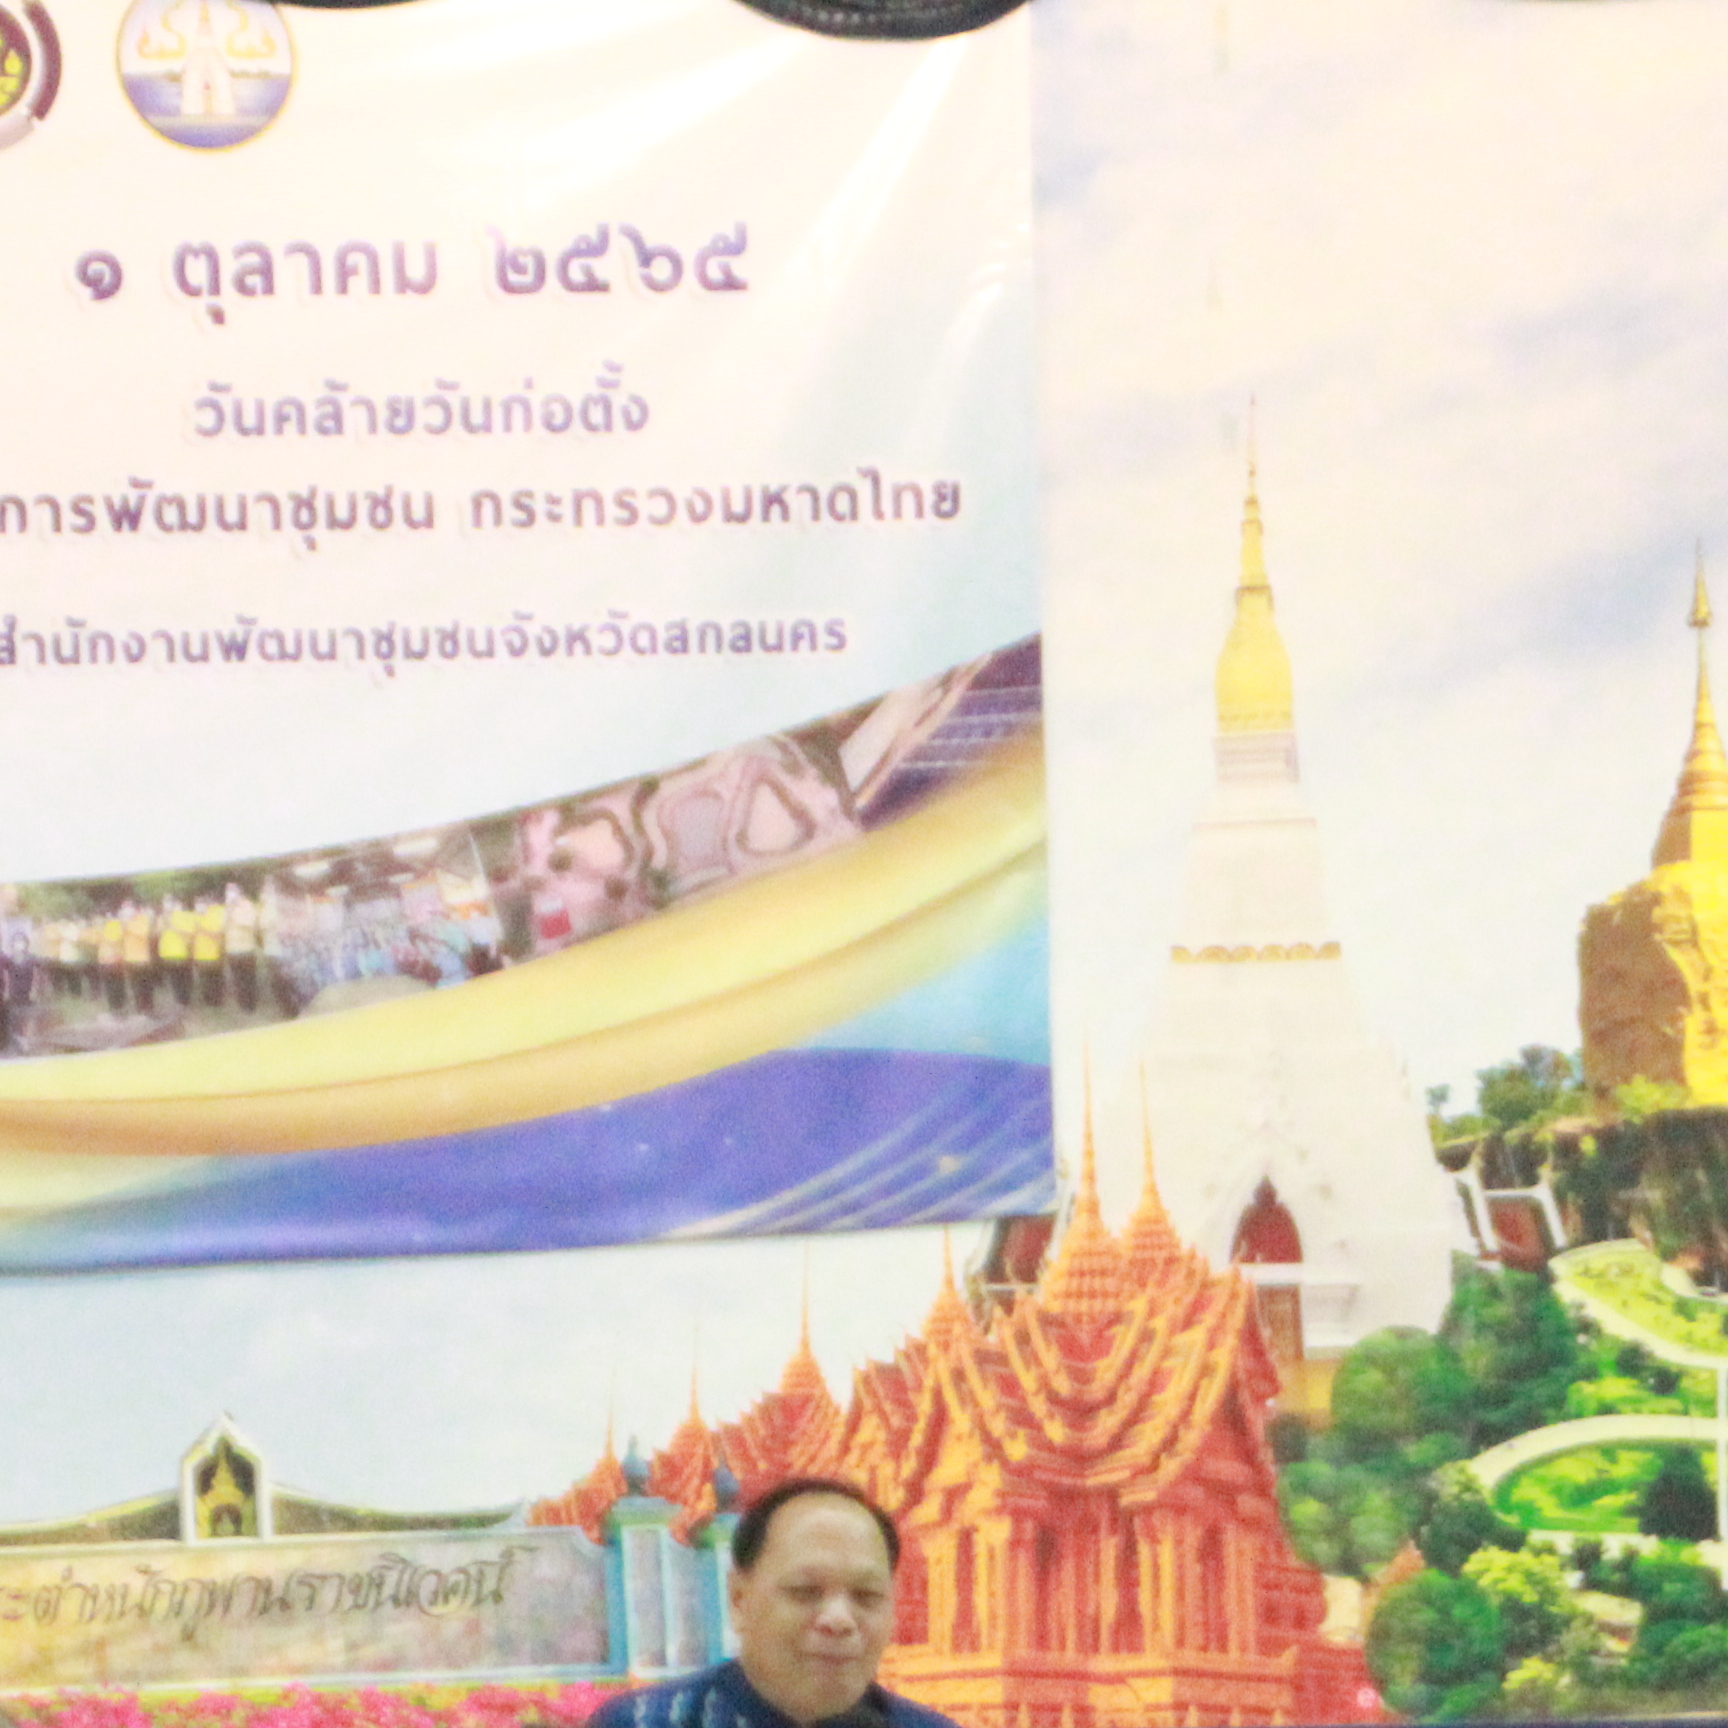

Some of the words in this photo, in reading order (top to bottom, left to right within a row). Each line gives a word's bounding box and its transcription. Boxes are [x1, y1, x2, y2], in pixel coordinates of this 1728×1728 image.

[173, 242, 438, 326] ตุลาคม
[494, 225, 749, 296] ๒๕๖๕
[194, 362, 650, 438] วันคล้ายวันก่อตั้ง
[470, 467, 962, 530] กระทรวงมหาดไทย
